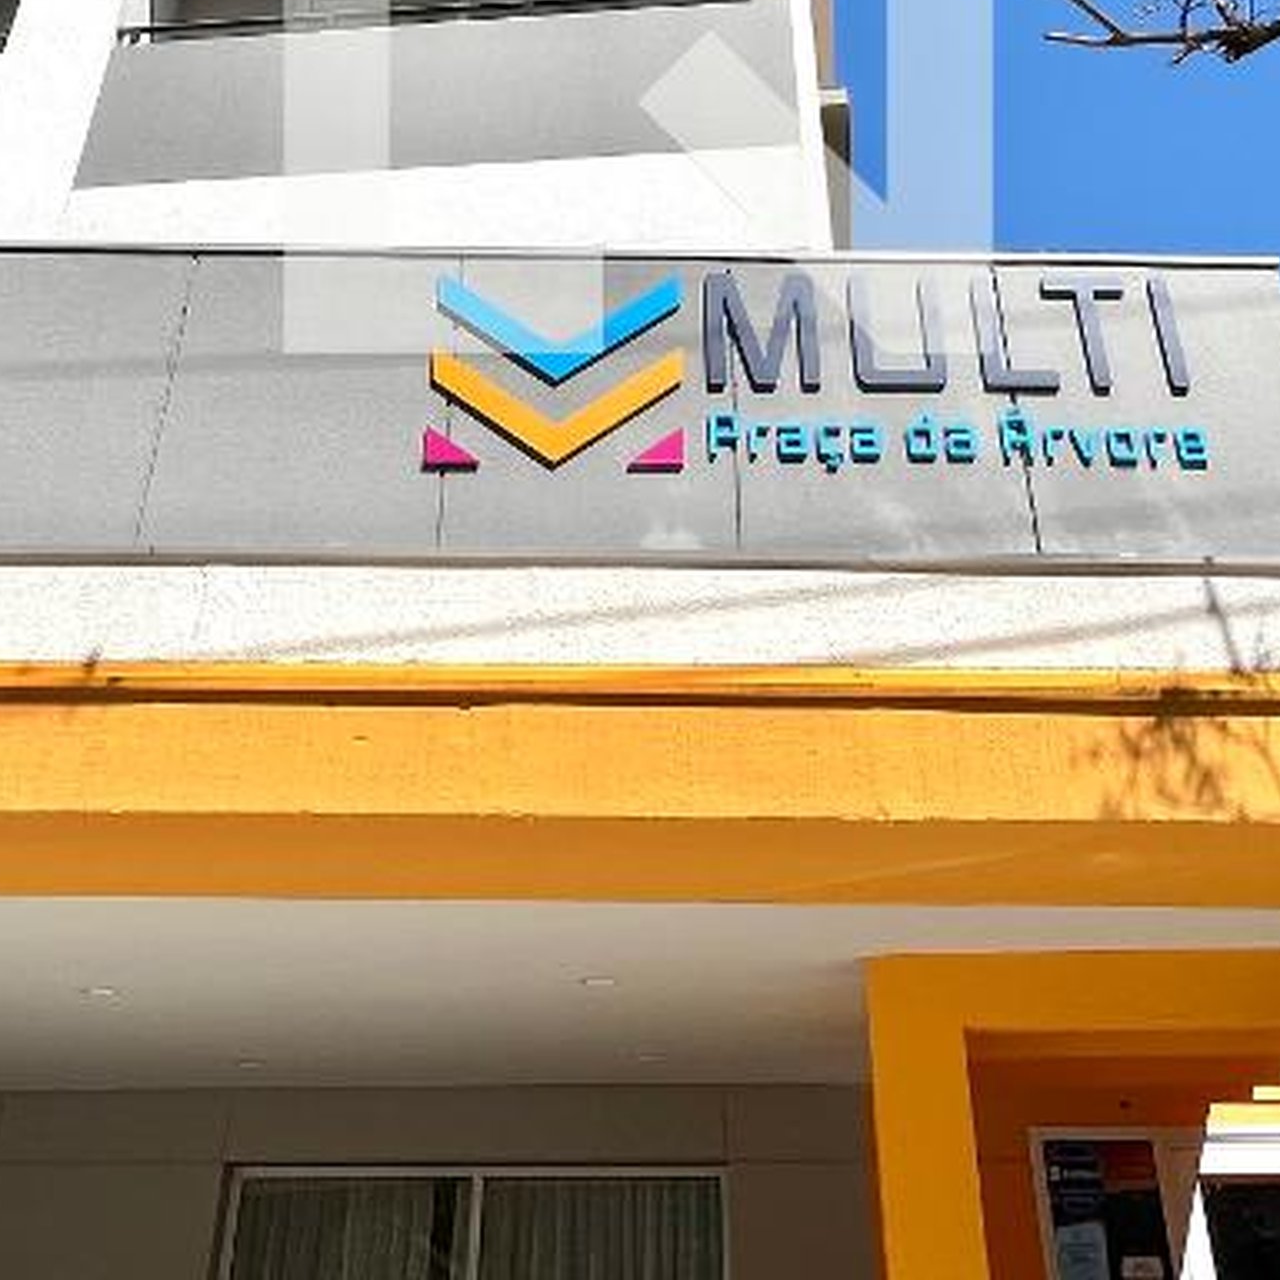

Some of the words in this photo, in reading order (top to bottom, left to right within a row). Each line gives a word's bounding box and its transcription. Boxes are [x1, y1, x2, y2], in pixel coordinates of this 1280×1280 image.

[702, 272, 1190, 398] MULTI
[706, 412, 885, 474] Praça
[903, 410, 979, 464] da
[996, 402, 1209, 470] Árvore
